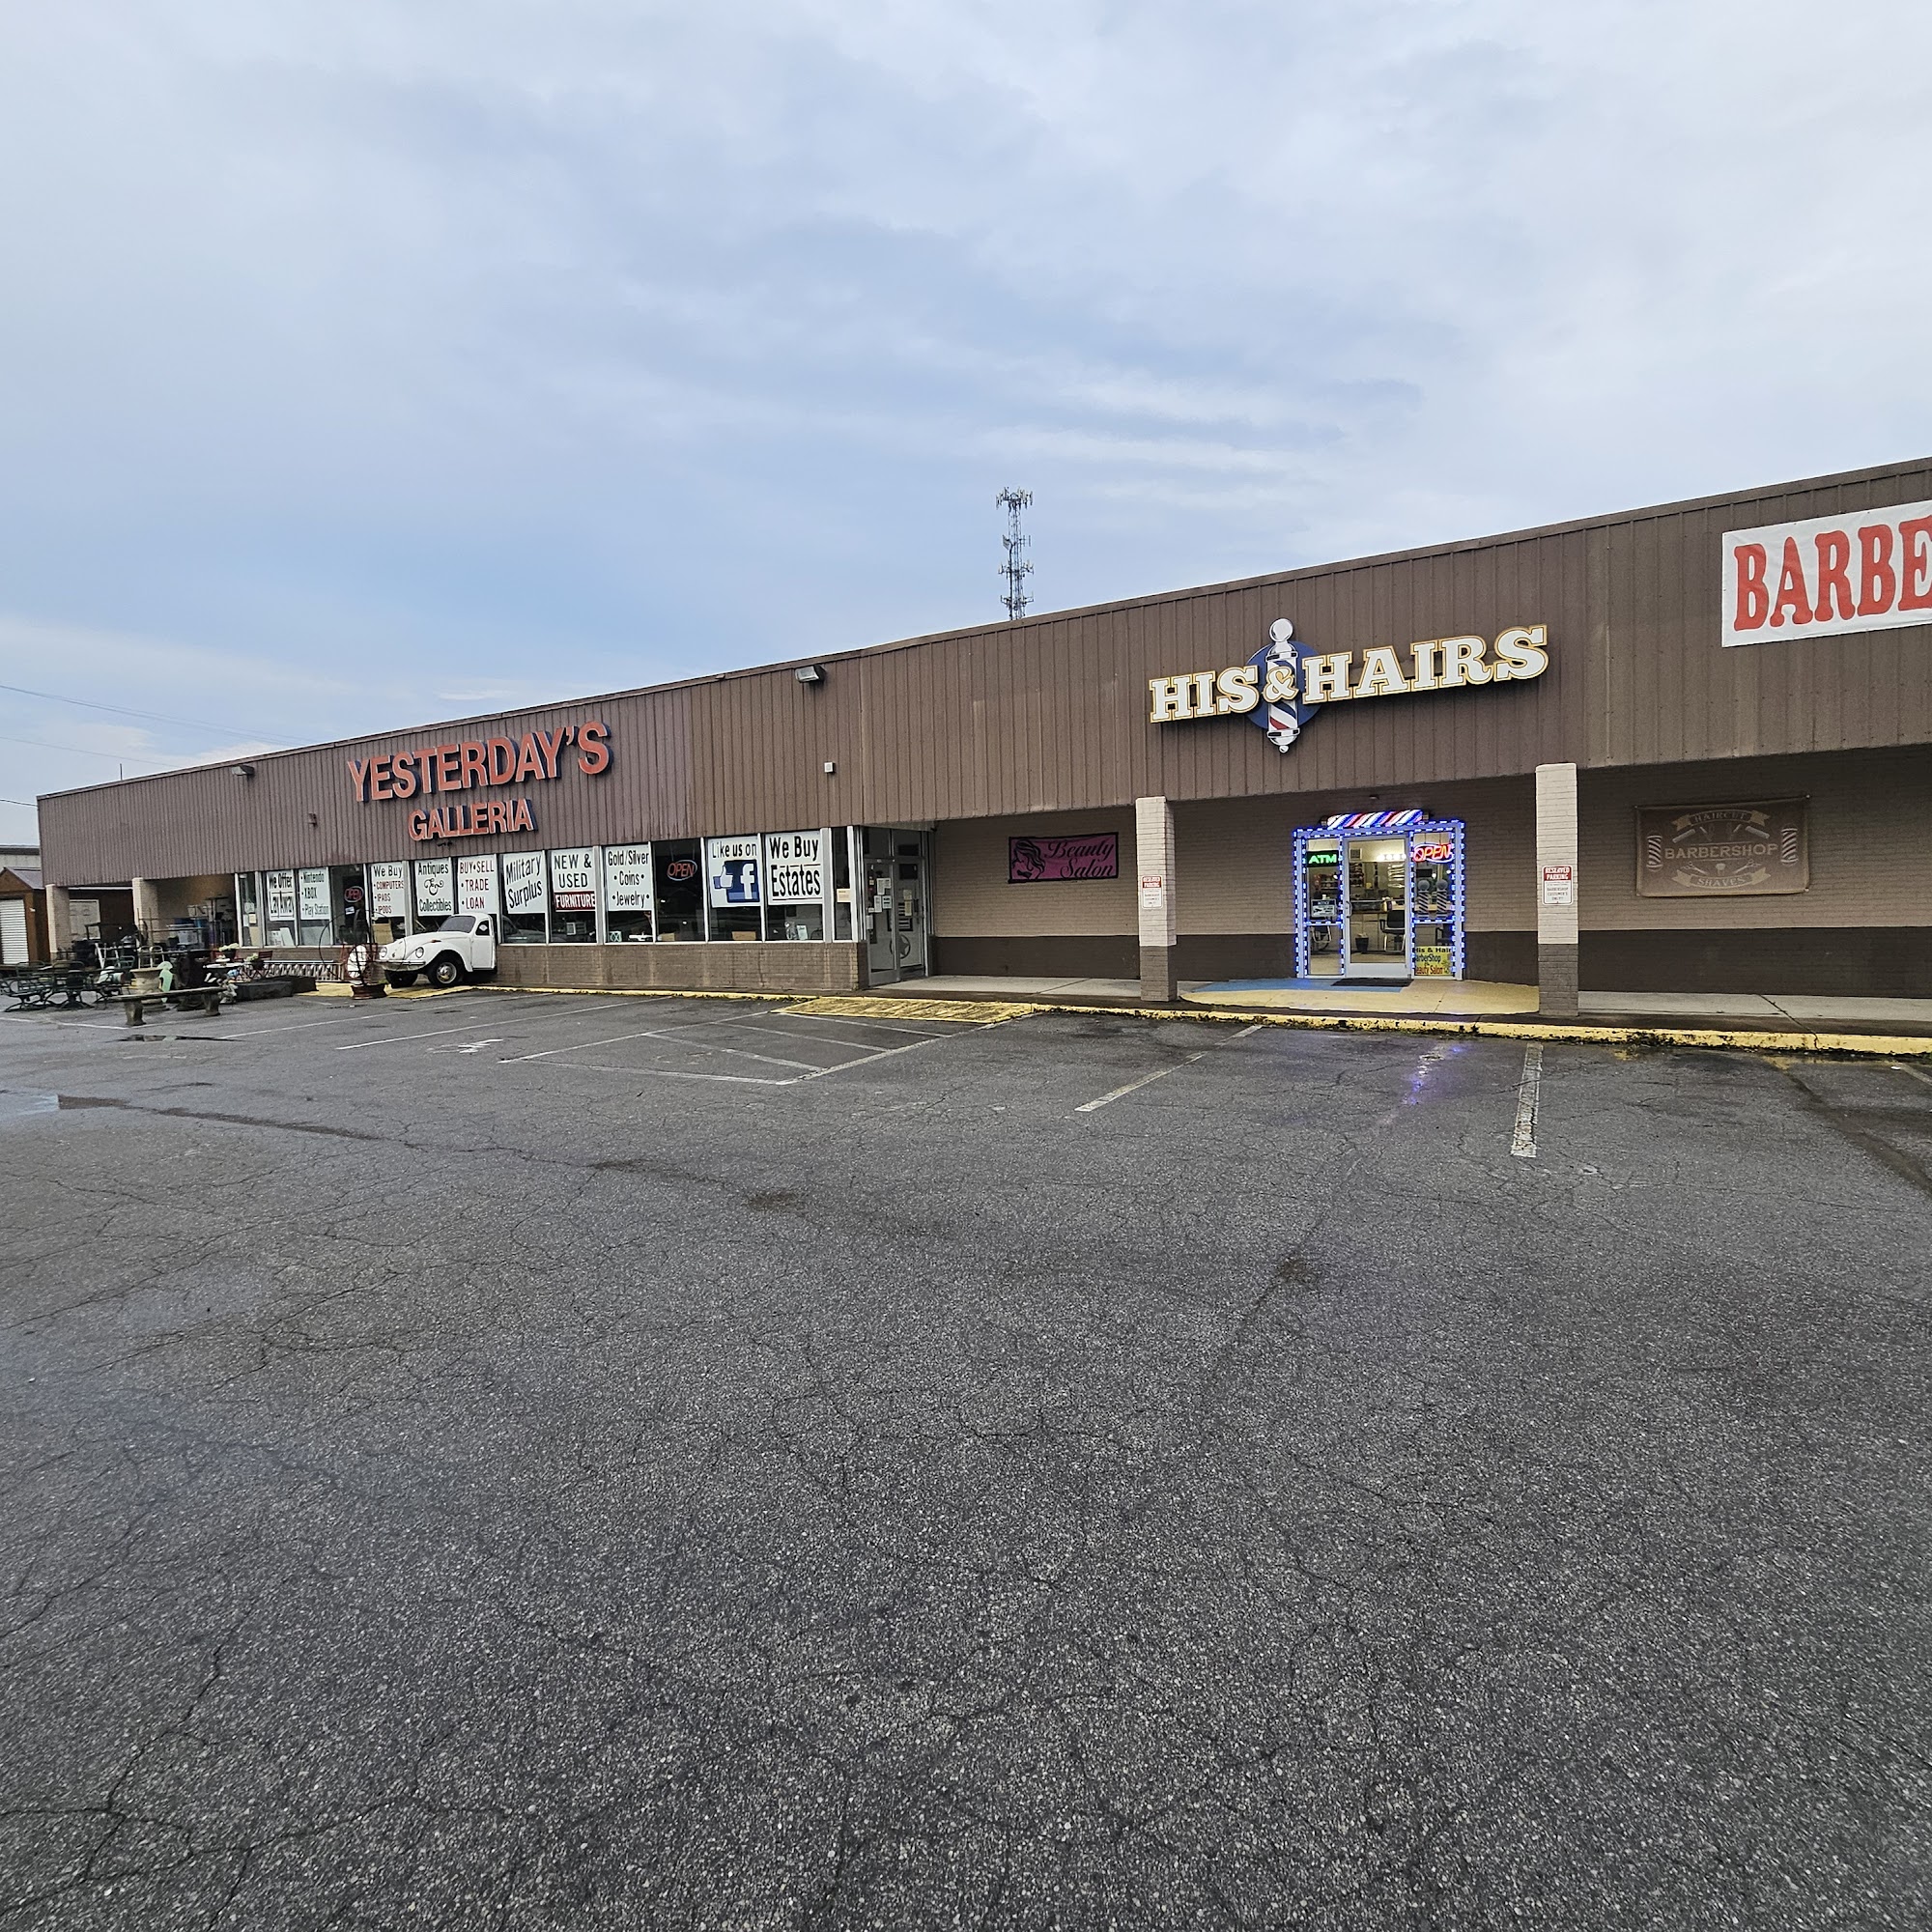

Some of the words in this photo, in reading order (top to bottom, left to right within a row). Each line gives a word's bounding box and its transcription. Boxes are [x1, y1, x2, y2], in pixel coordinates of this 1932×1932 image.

[1733, 515, 1932, 632] BARBE
[1150, 665, 1260, 724] HIS
[1262, 666, 1299, 703] &
[1302, 624, 1549, 705] HAIRS
[348, 721, 613, 803] YESTERDAY'S
[408, 798, 538, 841] GALLERIA
[608, 849, 649, 867] Gold/Silver
[712, 841, 729, 859] Like
[732, 843, 743, 857] us
[745, 842, 757, 856] on
[769, 837, 789, 859] We
[794, 836, 819, 862] Buy
[1044, 838, 1115, 862] Beauty
[1413, 843, 1452, 863] OPEN
[1664, 843, 1778, 860] BARBERSHOP
[554, 854, 579, 869] NEW
[583, 853, 592, 868] &
[1060, 858, 1114, 878] Salon
[1309, 854, 1337, 865] ATM
[373, 866, 385, 877] We
[387, 866, 403, 878] Buy
[417, 862, 449, 877] Antiques
[506, 855, 542, 885] Military
[667, 863, 696, 878] OPEN
[270, 872, 277, 889] We
[277, 871, 293, 889] Offer
[376, 880, 404, 890] COMPUTERS
[465, 878, 490, 892] TRADE
[558, 872, 588, 889] USED
[770, 865, 821, 897] Estates
[1696, 877, 1746, 887] SHAVES
[466, 896, 485, 910] LOAN
[507, 879, 543, 909] Surplus
[554, 894, 595, 909] FURNITURE
[418, 898, 452, 912] Collectibles
